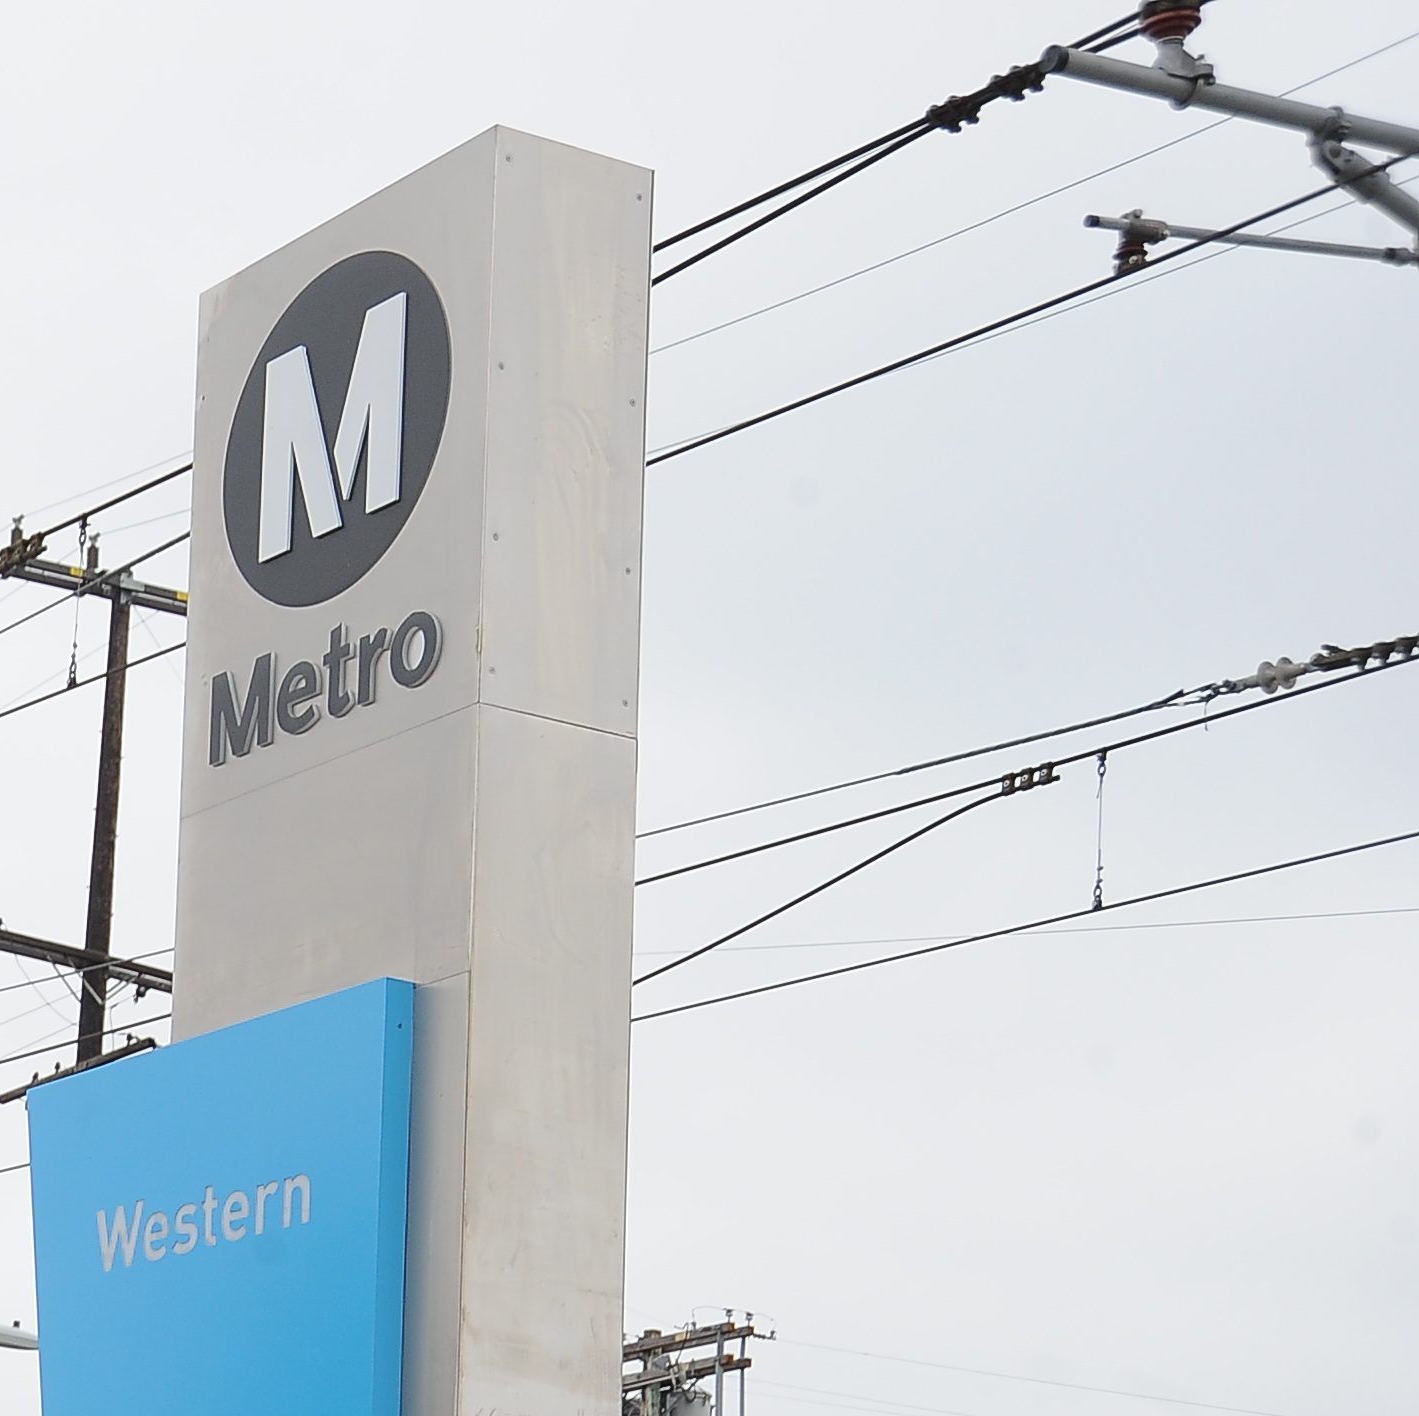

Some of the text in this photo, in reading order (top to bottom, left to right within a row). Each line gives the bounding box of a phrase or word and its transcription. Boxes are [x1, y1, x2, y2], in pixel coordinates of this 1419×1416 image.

[259, 291, 407, 564] M
[209, 611, 442, 768] Metro
[96, 1172, 312, 1273] Western
